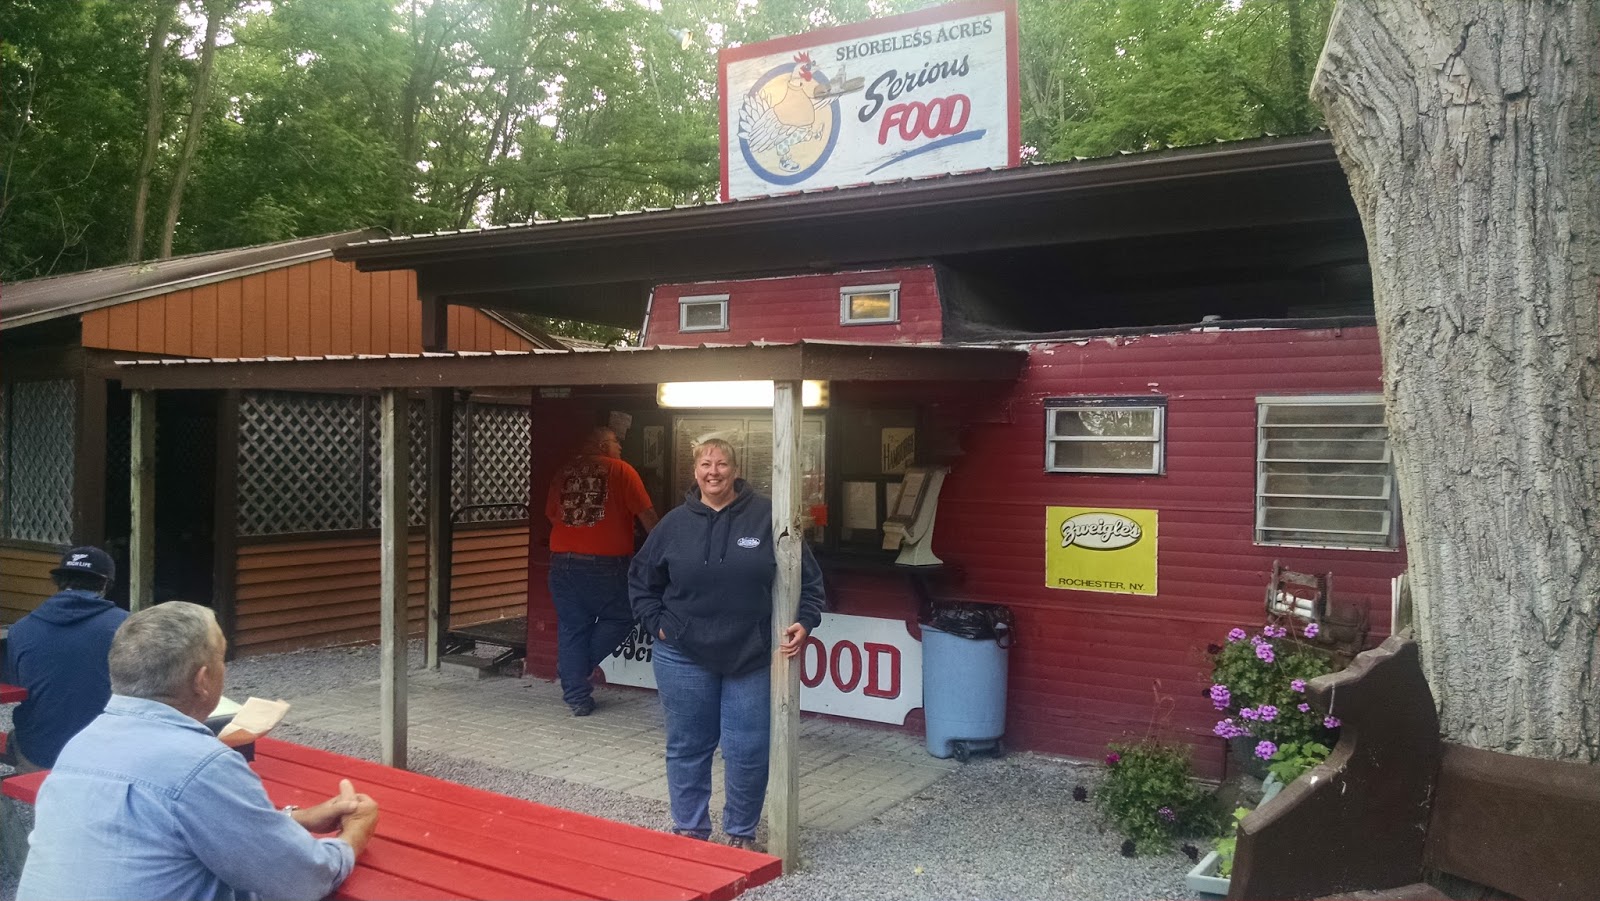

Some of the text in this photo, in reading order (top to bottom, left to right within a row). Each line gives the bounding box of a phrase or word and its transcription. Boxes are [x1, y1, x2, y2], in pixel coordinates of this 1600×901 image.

[836, 19, 992, 62] SHORELESS ACRES
[858, 54, 970, 123] Serious
[877, 93, 971, 145] FOOD
[1061, 519, 1141, 548] Zweigle's
[1058, 578, 1125, 590] ROCHESTER,
[800, 636, 901, 699] OOD
